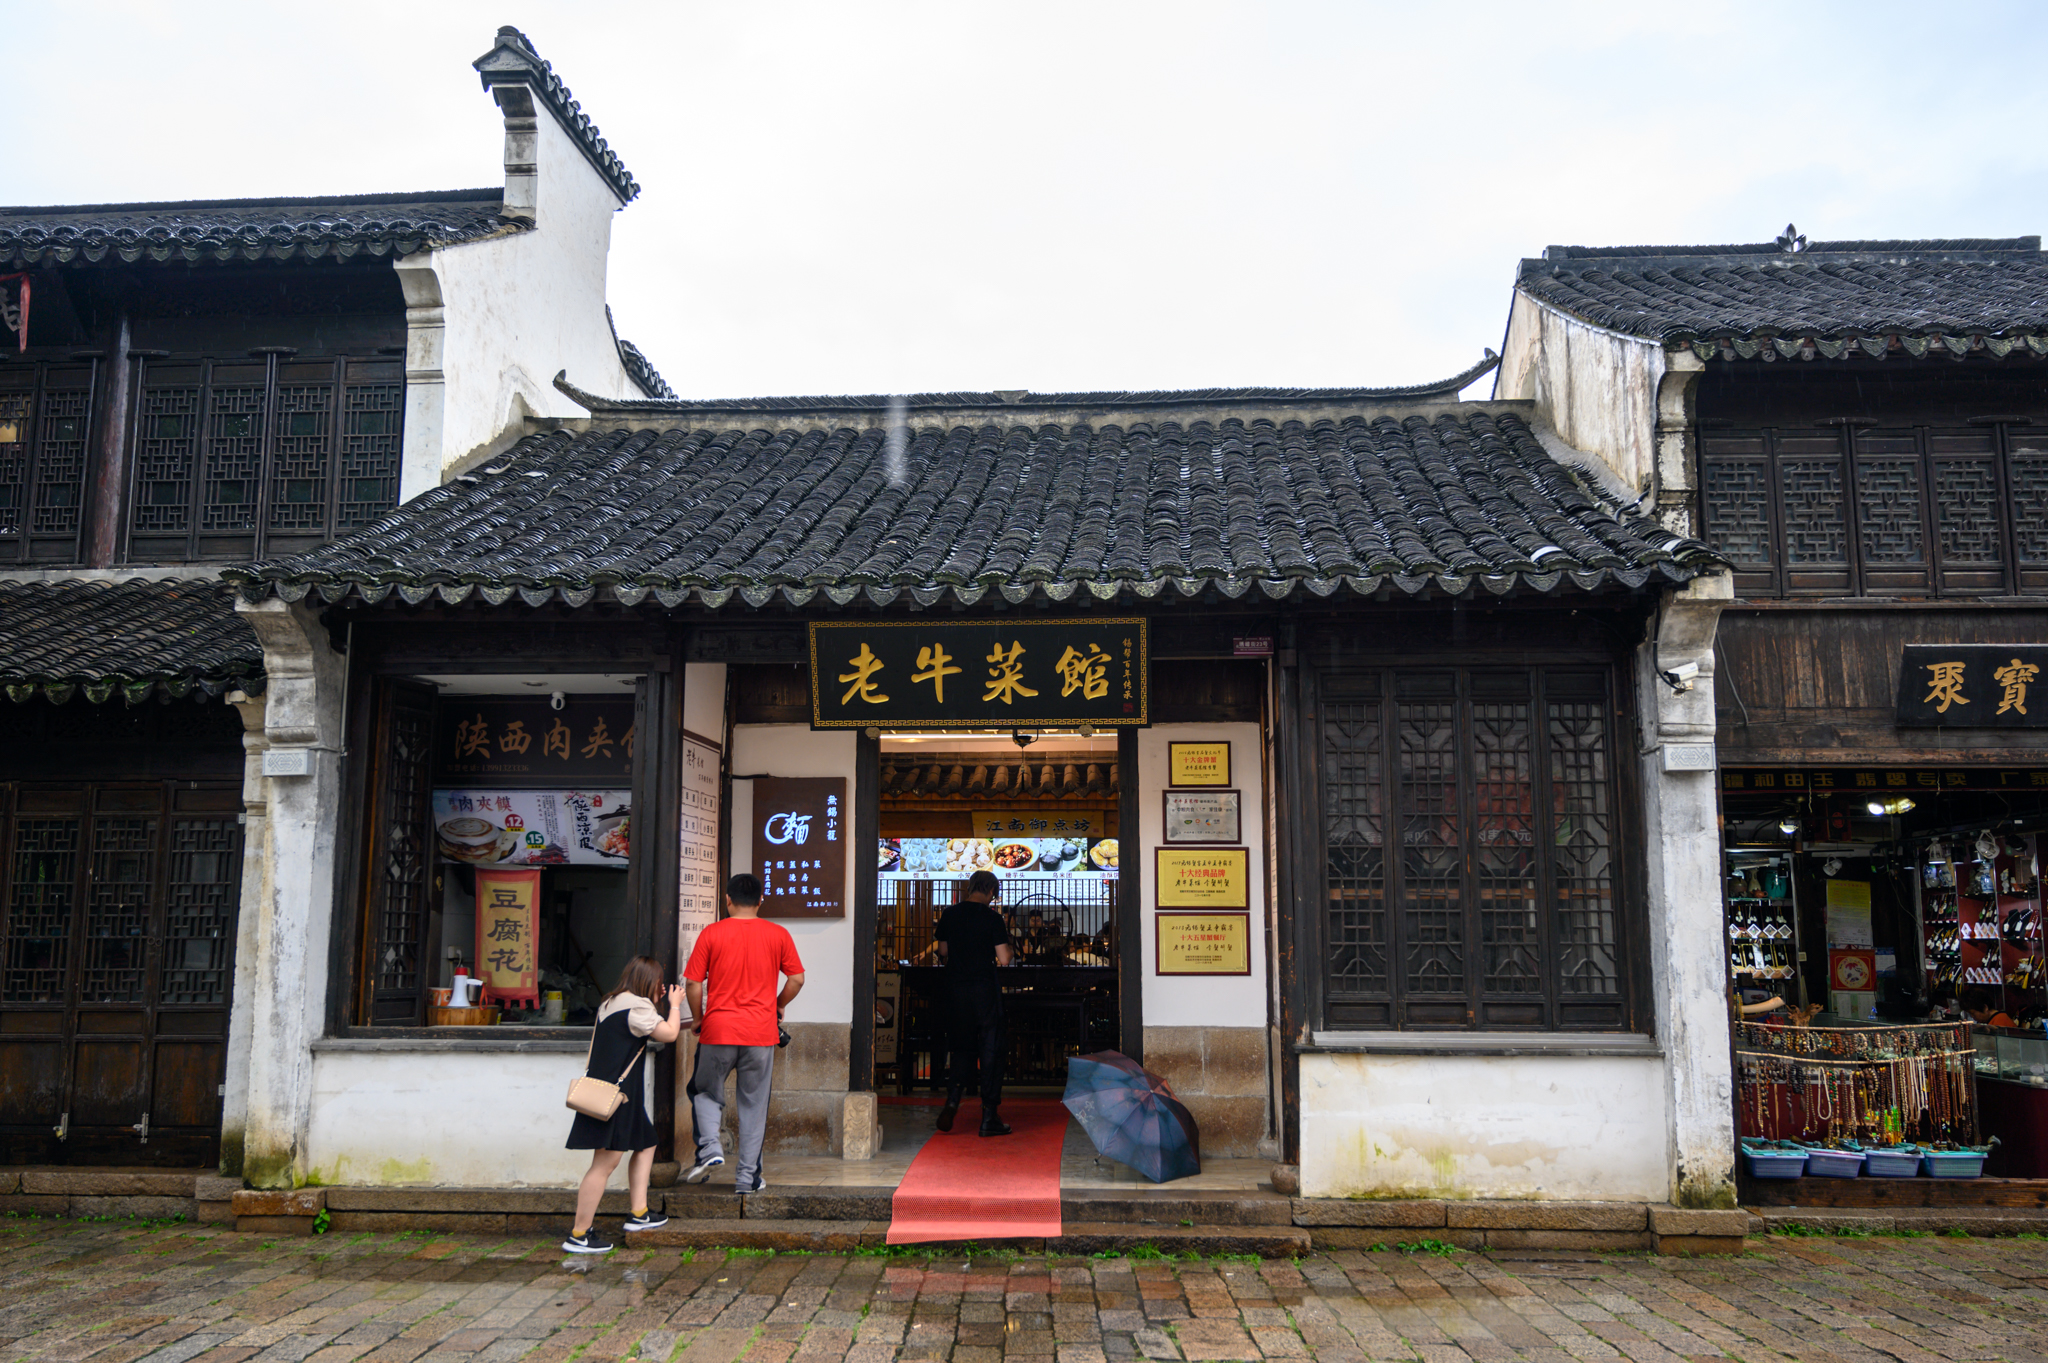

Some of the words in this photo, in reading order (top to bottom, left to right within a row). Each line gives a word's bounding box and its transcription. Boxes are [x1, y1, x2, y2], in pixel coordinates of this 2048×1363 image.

[838, 640, 1112, 705] 老牛菜館
[1924, 658, 2041, 715] 聚寶
[1856, 772, 1967, 787] 翡翠专卖
[986, 818, 1091, 832] 江南御点坊
[1005, 871, 1026, 879] 糖芋头
[1179, 869, 1226, 877] 十大经典品牌
[487, 888, 526, 973] 豆腐花
